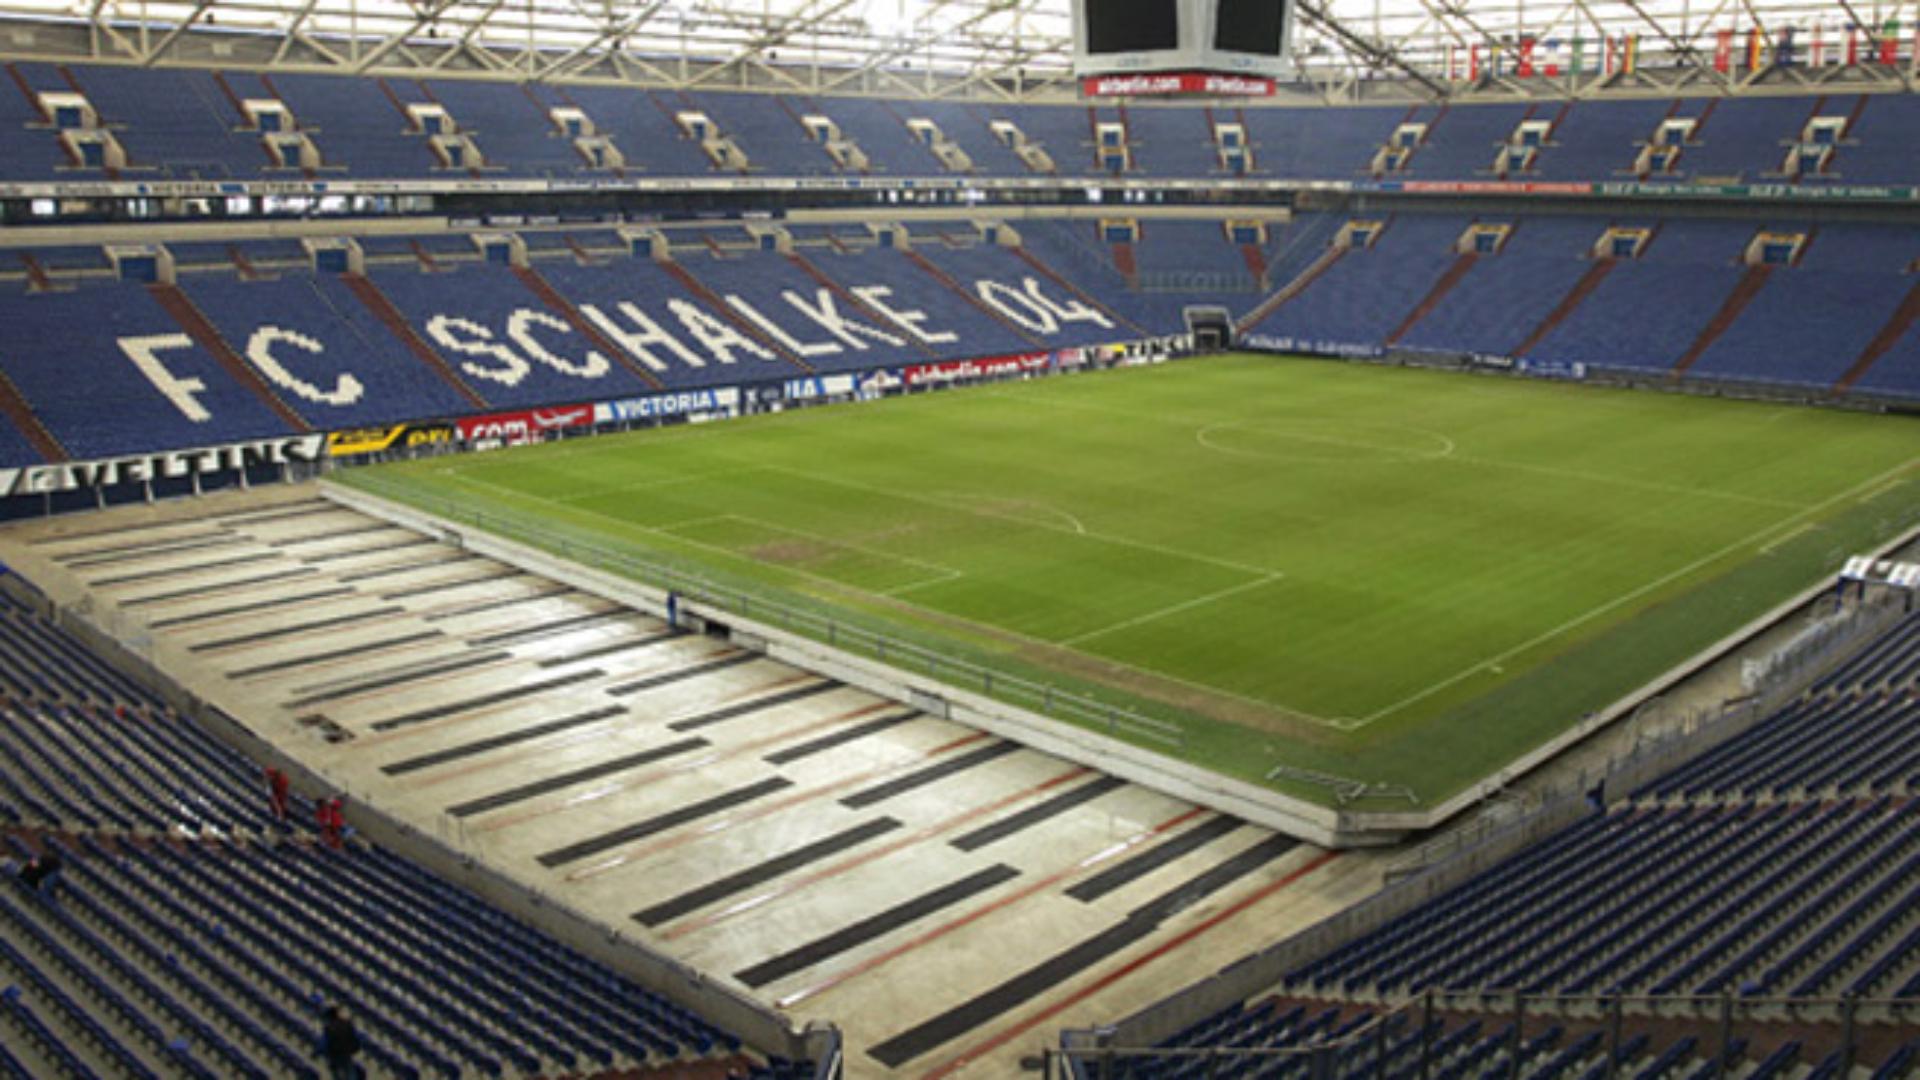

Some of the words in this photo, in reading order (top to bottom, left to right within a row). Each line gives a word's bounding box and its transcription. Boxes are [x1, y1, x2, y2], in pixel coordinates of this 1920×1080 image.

[426, 285, 958, 386] SCHALKE
[976, 278, 1118, 335] 04
[616, 389, 710, 418] VICTORIA
